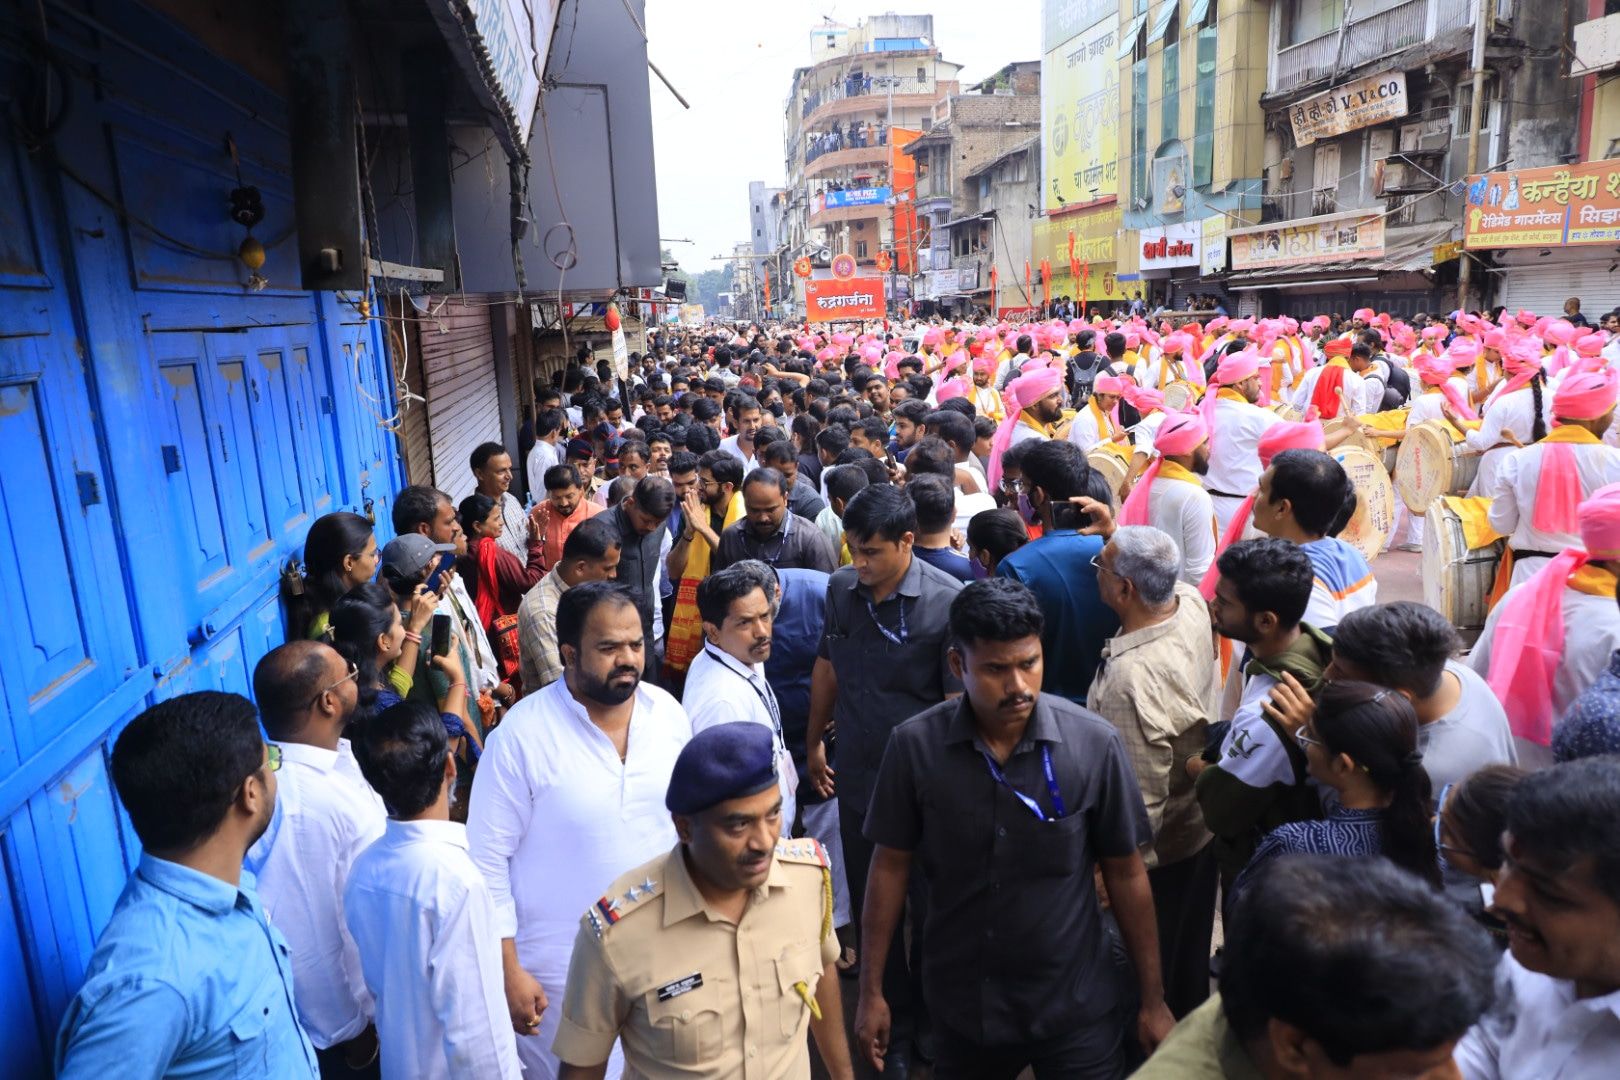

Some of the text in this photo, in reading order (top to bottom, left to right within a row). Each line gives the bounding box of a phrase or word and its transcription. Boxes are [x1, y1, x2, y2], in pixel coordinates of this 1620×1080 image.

[1067, 42, 1086, 69] जागो
[1378, 81, 1401, 98] CO.
[1522, 170, 1599, 205] कन्हैया
[816, 291, 873, 309] रुद्रगर्जना
